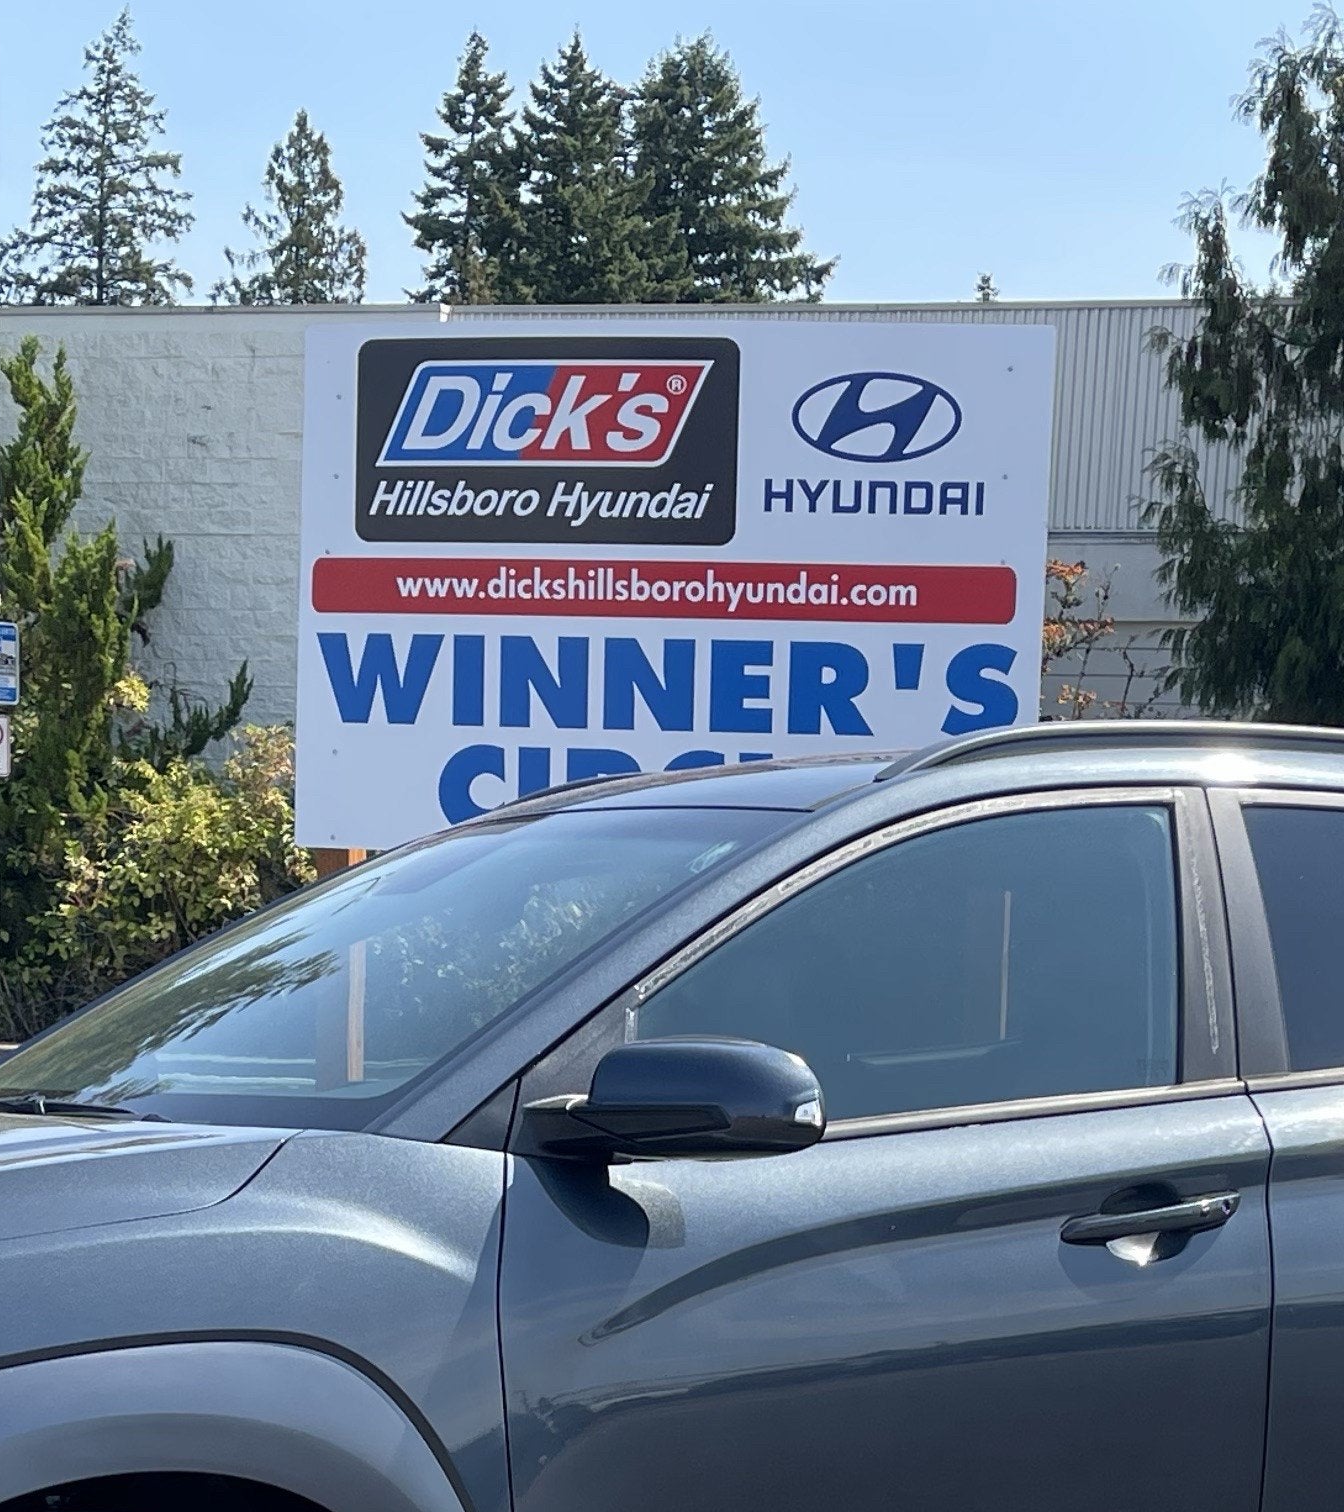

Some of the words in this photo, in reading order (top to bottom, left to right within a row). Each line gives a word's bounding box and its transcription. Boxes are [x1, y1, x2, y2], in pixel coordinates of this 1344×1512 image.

[401, 370, 671, 453] Dick's
[369, 480, 539, 519] Hillsboro
[546, 480, 715, 527] Hyundai
[764, 478, 985, 517] HYUNDAI
[396, 566, 918, 613] www.dickshillsborohyundai.com
[316, 632, 1019, 735] WINNER'S
